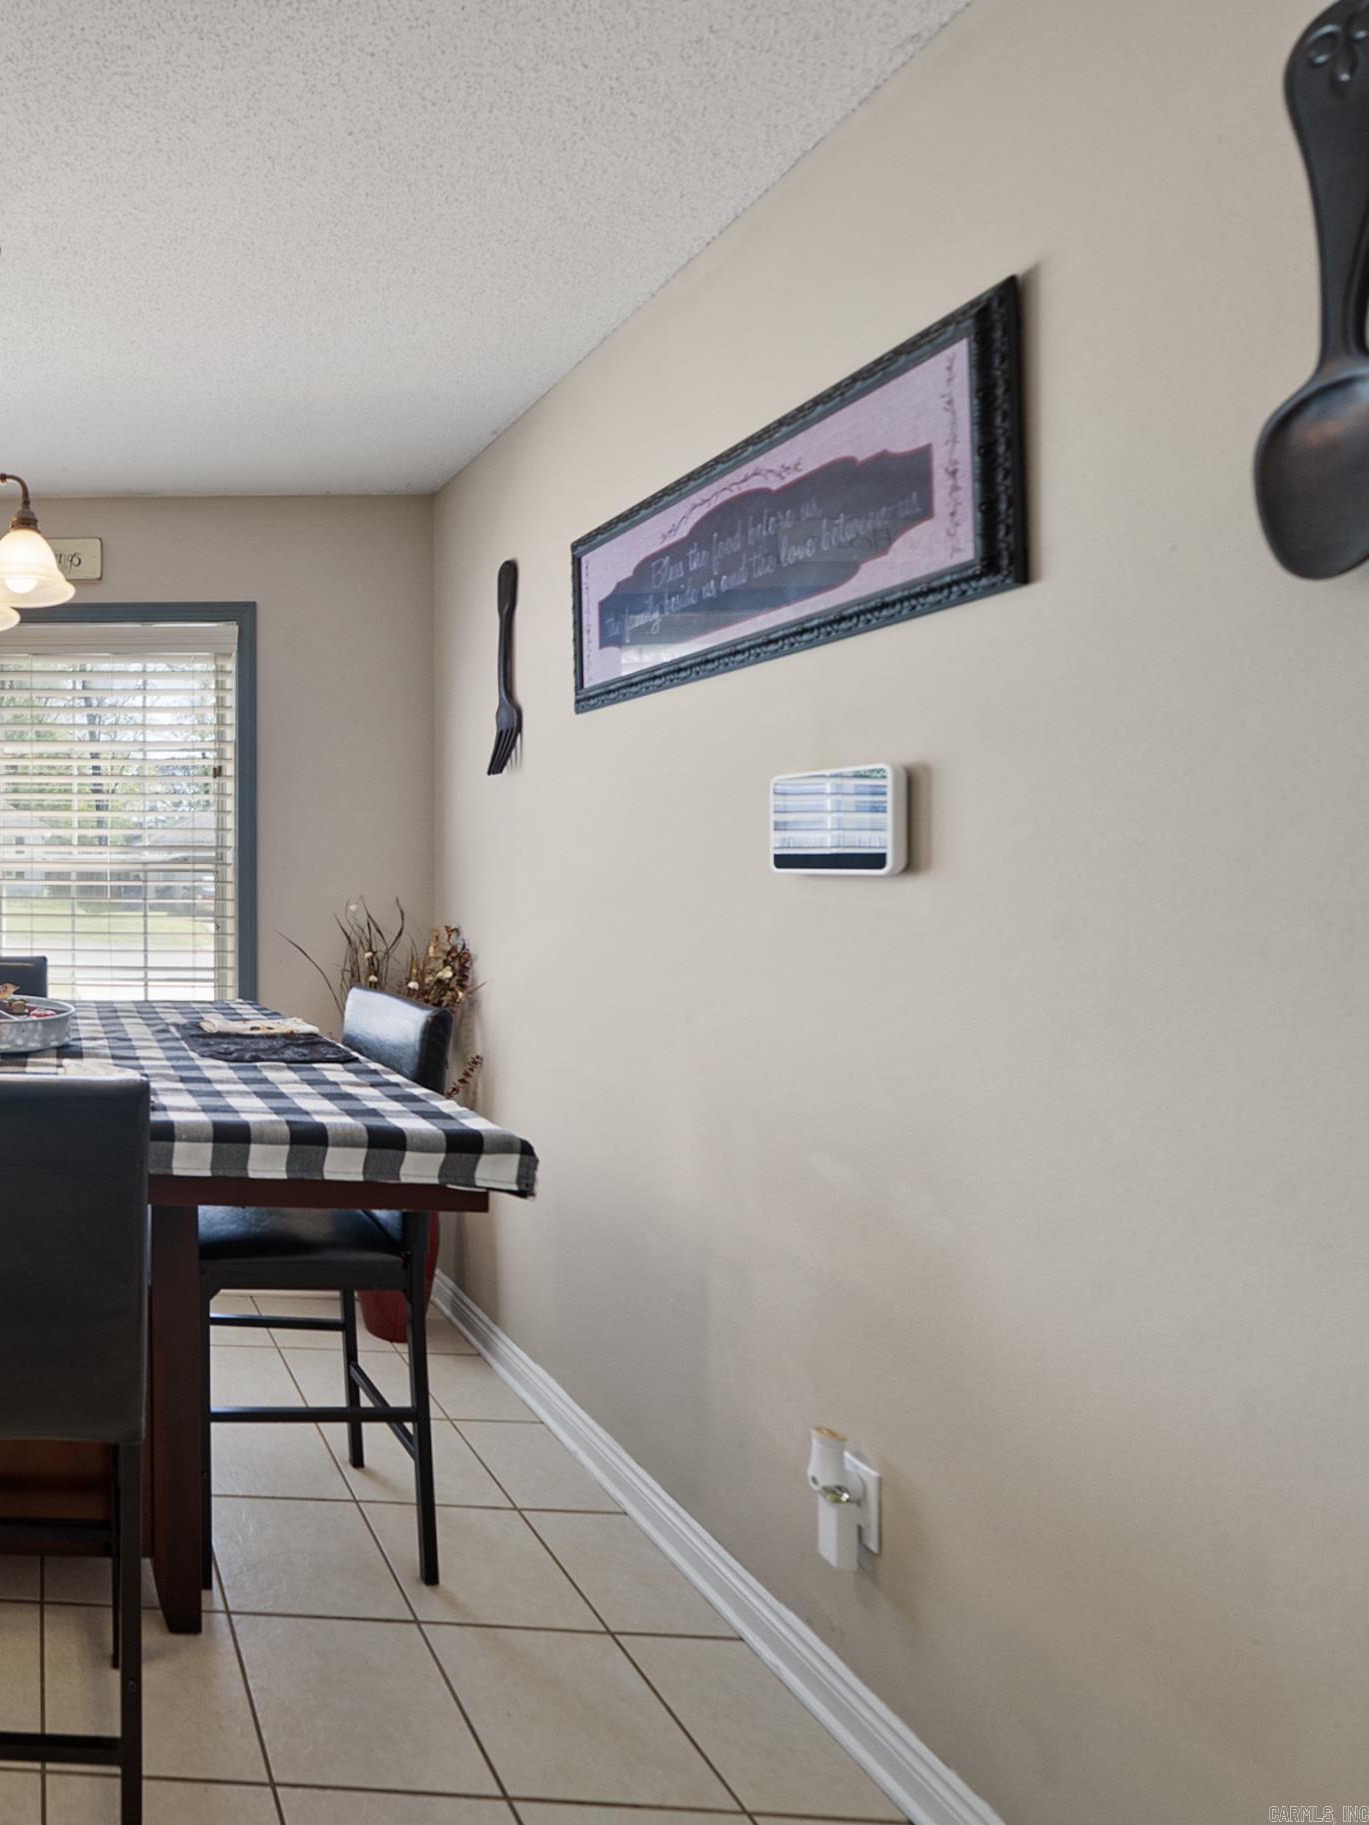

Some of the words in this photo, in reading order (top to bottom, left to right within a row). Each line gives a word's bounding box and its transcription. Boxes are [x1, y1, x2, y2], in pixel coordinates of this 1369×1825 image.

[651, 556, 684, 589] Bless
[686, 541, 710, 571] the
[712, 519, 742, 575] food
[748, 508, 794, 545] before
[664, 577, 698, 615] beside
[720, 553, 748, 592] and
[748, 545, 776, 578] the
[780, 535, 815, 567] love
